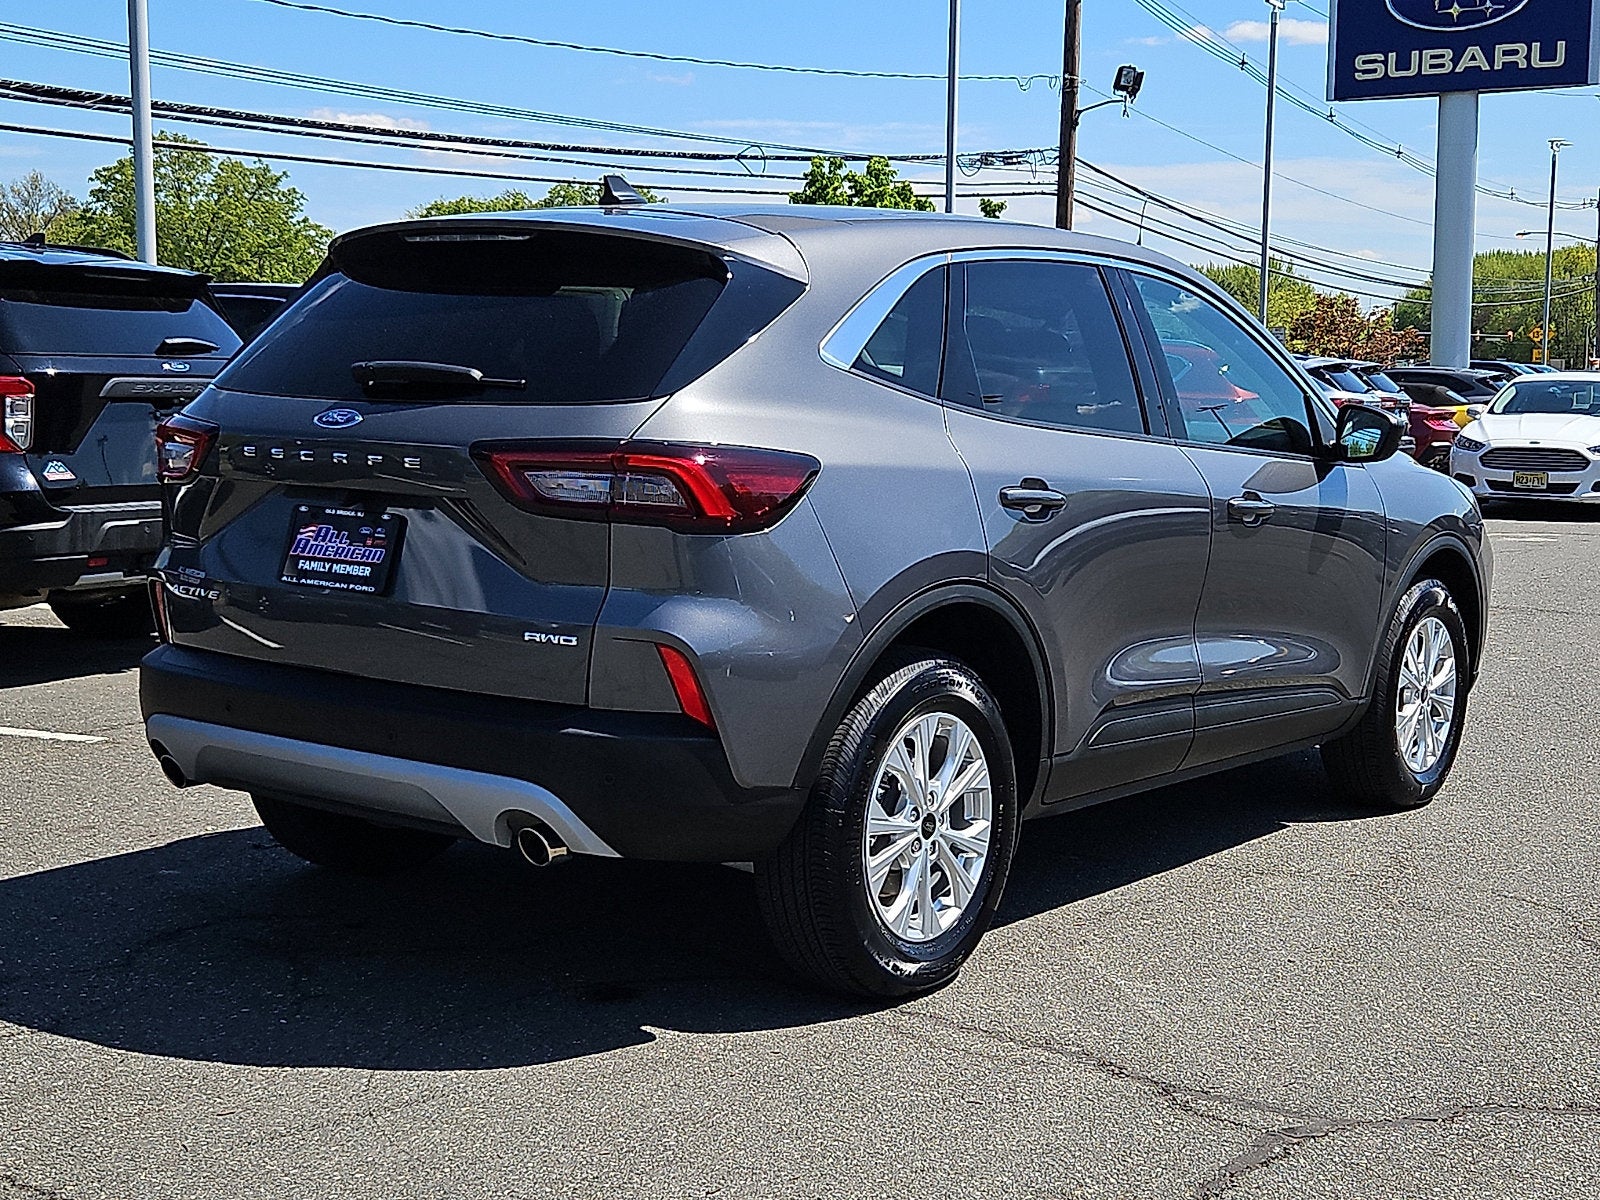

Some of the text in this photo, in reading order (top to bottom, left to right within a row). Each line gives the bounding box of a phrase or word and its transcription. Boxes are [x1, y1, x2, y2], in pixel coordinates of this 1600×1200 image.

[1354, 41, 1566, 81] SUBARU
[131, 384, 205, 393] EXPLOR
[243, 446, 421, 469] ESCAPE
[298, 559, 371, 577] FAMILY MEMBER
[172, 584, 220, 600] ACTIVE
[281, 575, 375, 593] ALL AMERICAN FORD
[524, 631, 578, 646] AWD
